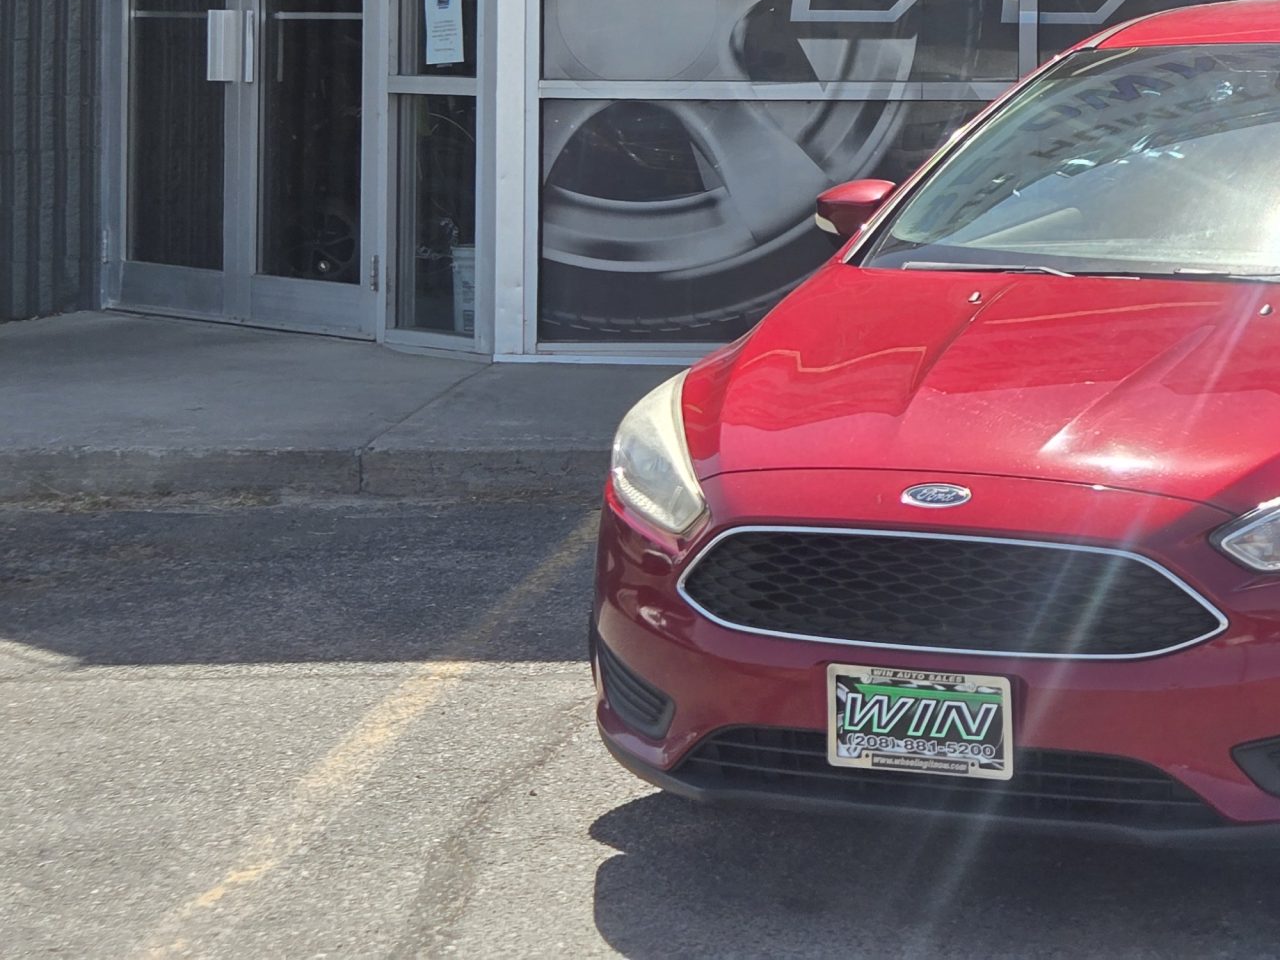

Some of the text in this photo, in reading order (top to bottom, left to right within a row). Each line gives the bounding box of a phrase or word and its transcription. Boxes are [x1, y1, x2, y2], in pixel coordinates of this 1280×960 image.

[872, 668, 963, 684] WIN AUTO SALES
[843, 692, 999, 741] WIN
